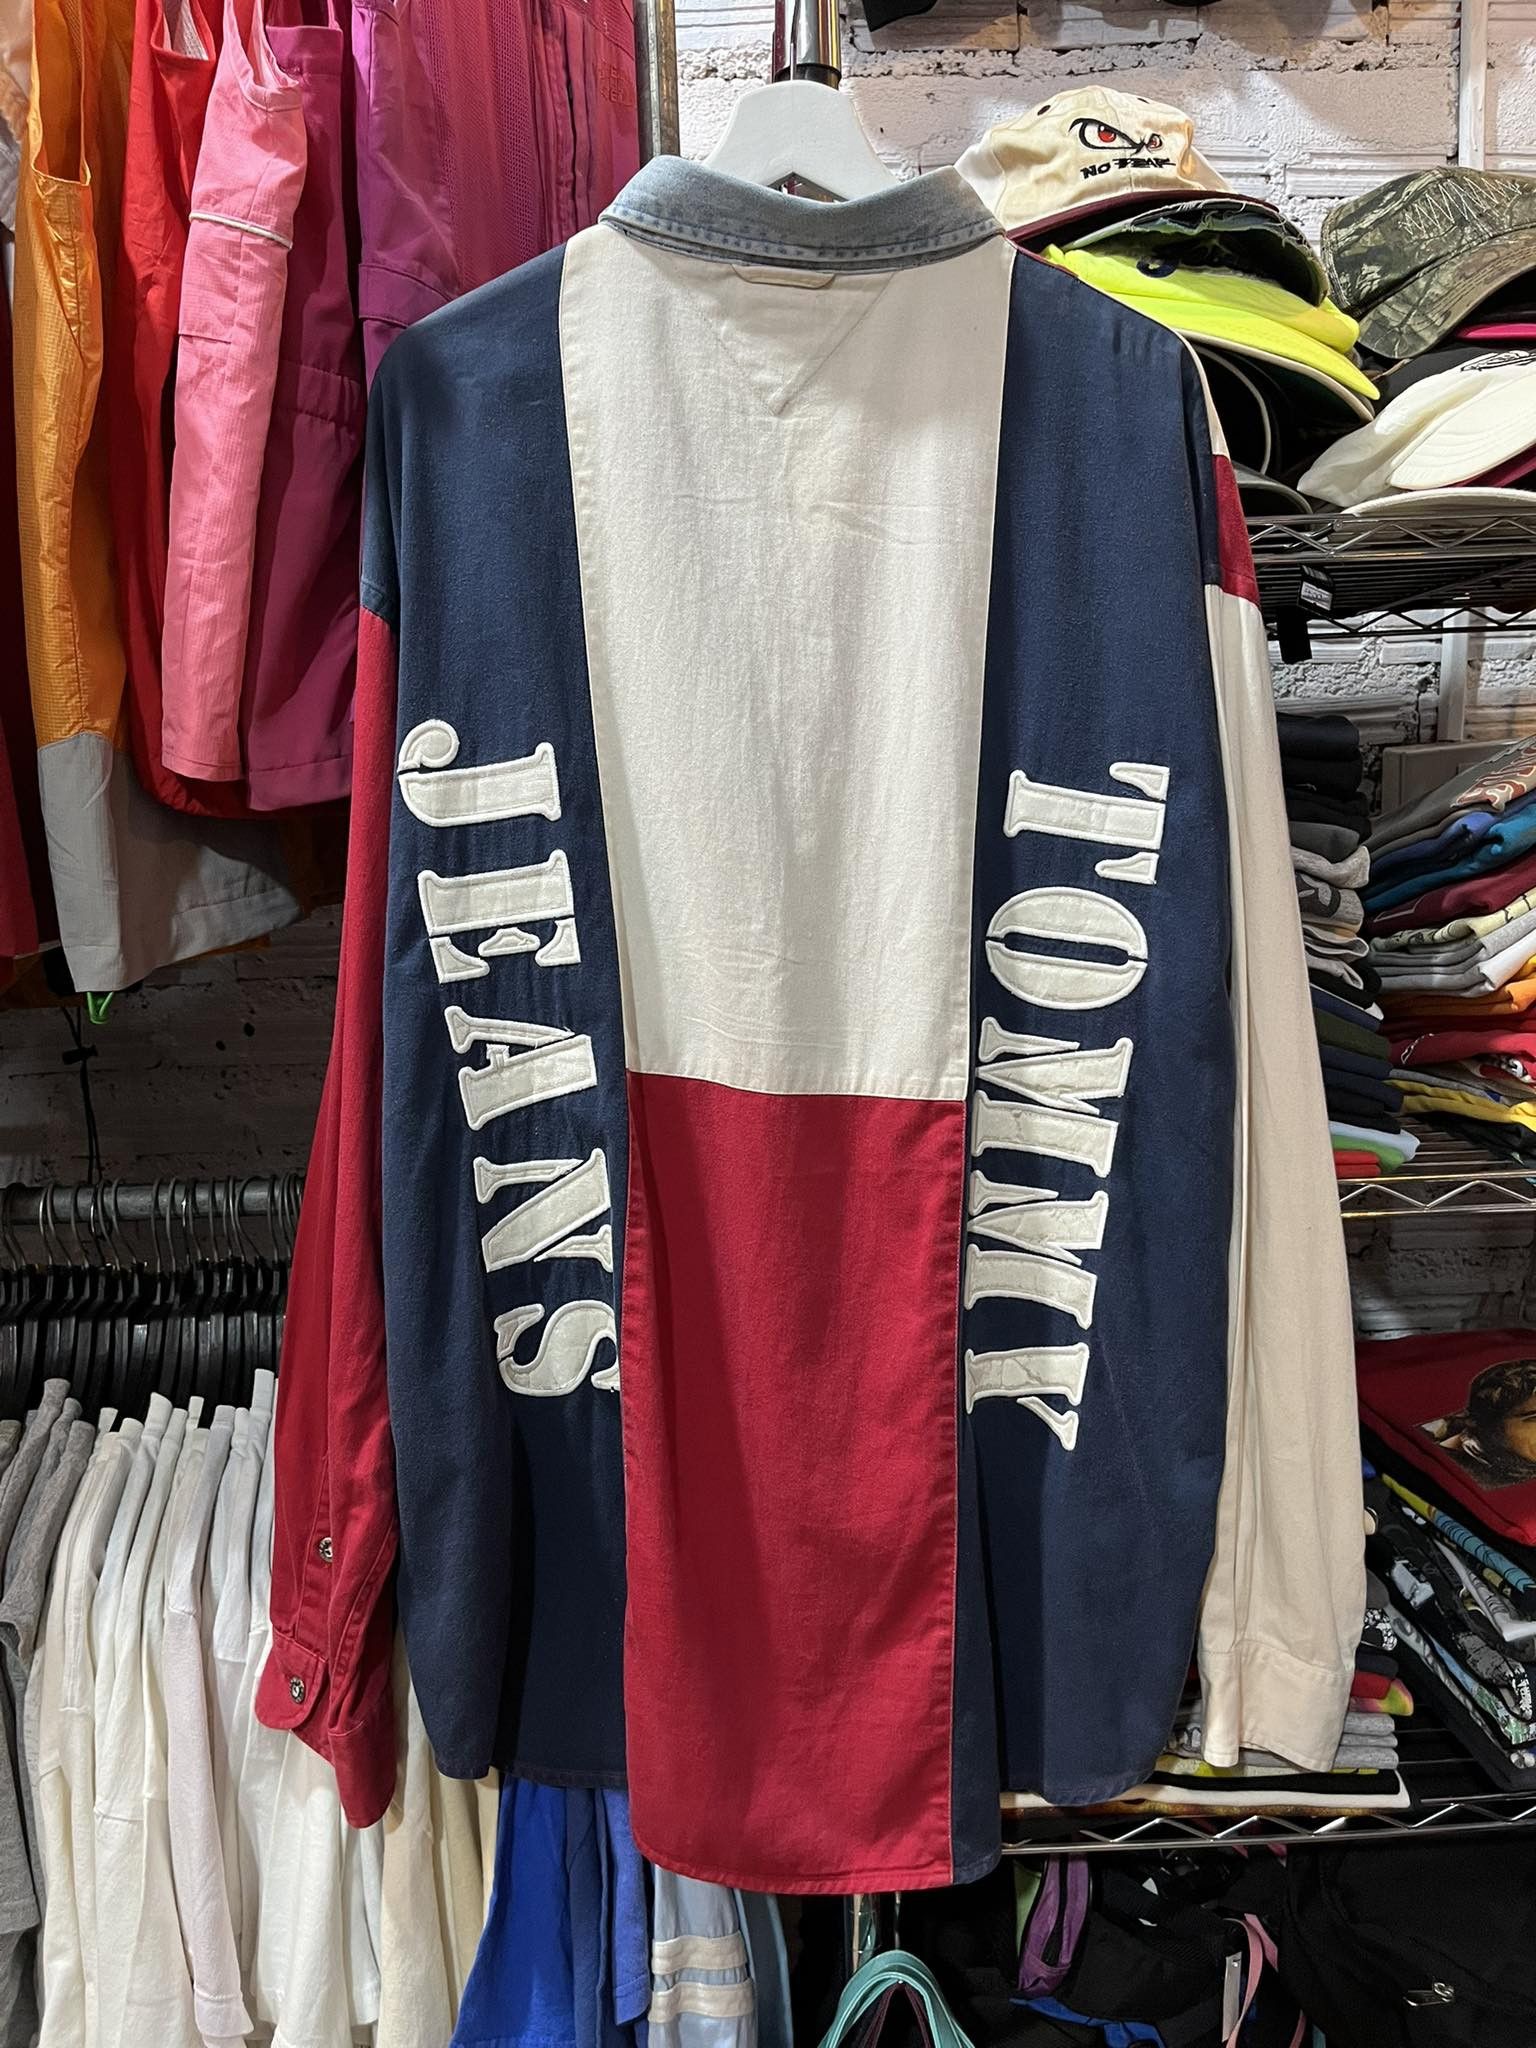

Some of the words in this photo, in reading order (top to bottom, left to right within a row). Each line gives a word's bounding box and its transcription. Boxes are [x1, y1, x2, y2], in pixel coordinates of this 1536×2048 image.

[1080, 162, 1112, 179] NO
[397, 718, 621, 1398] JEANS
[964, 761, 1171, 1452] TOMMY
